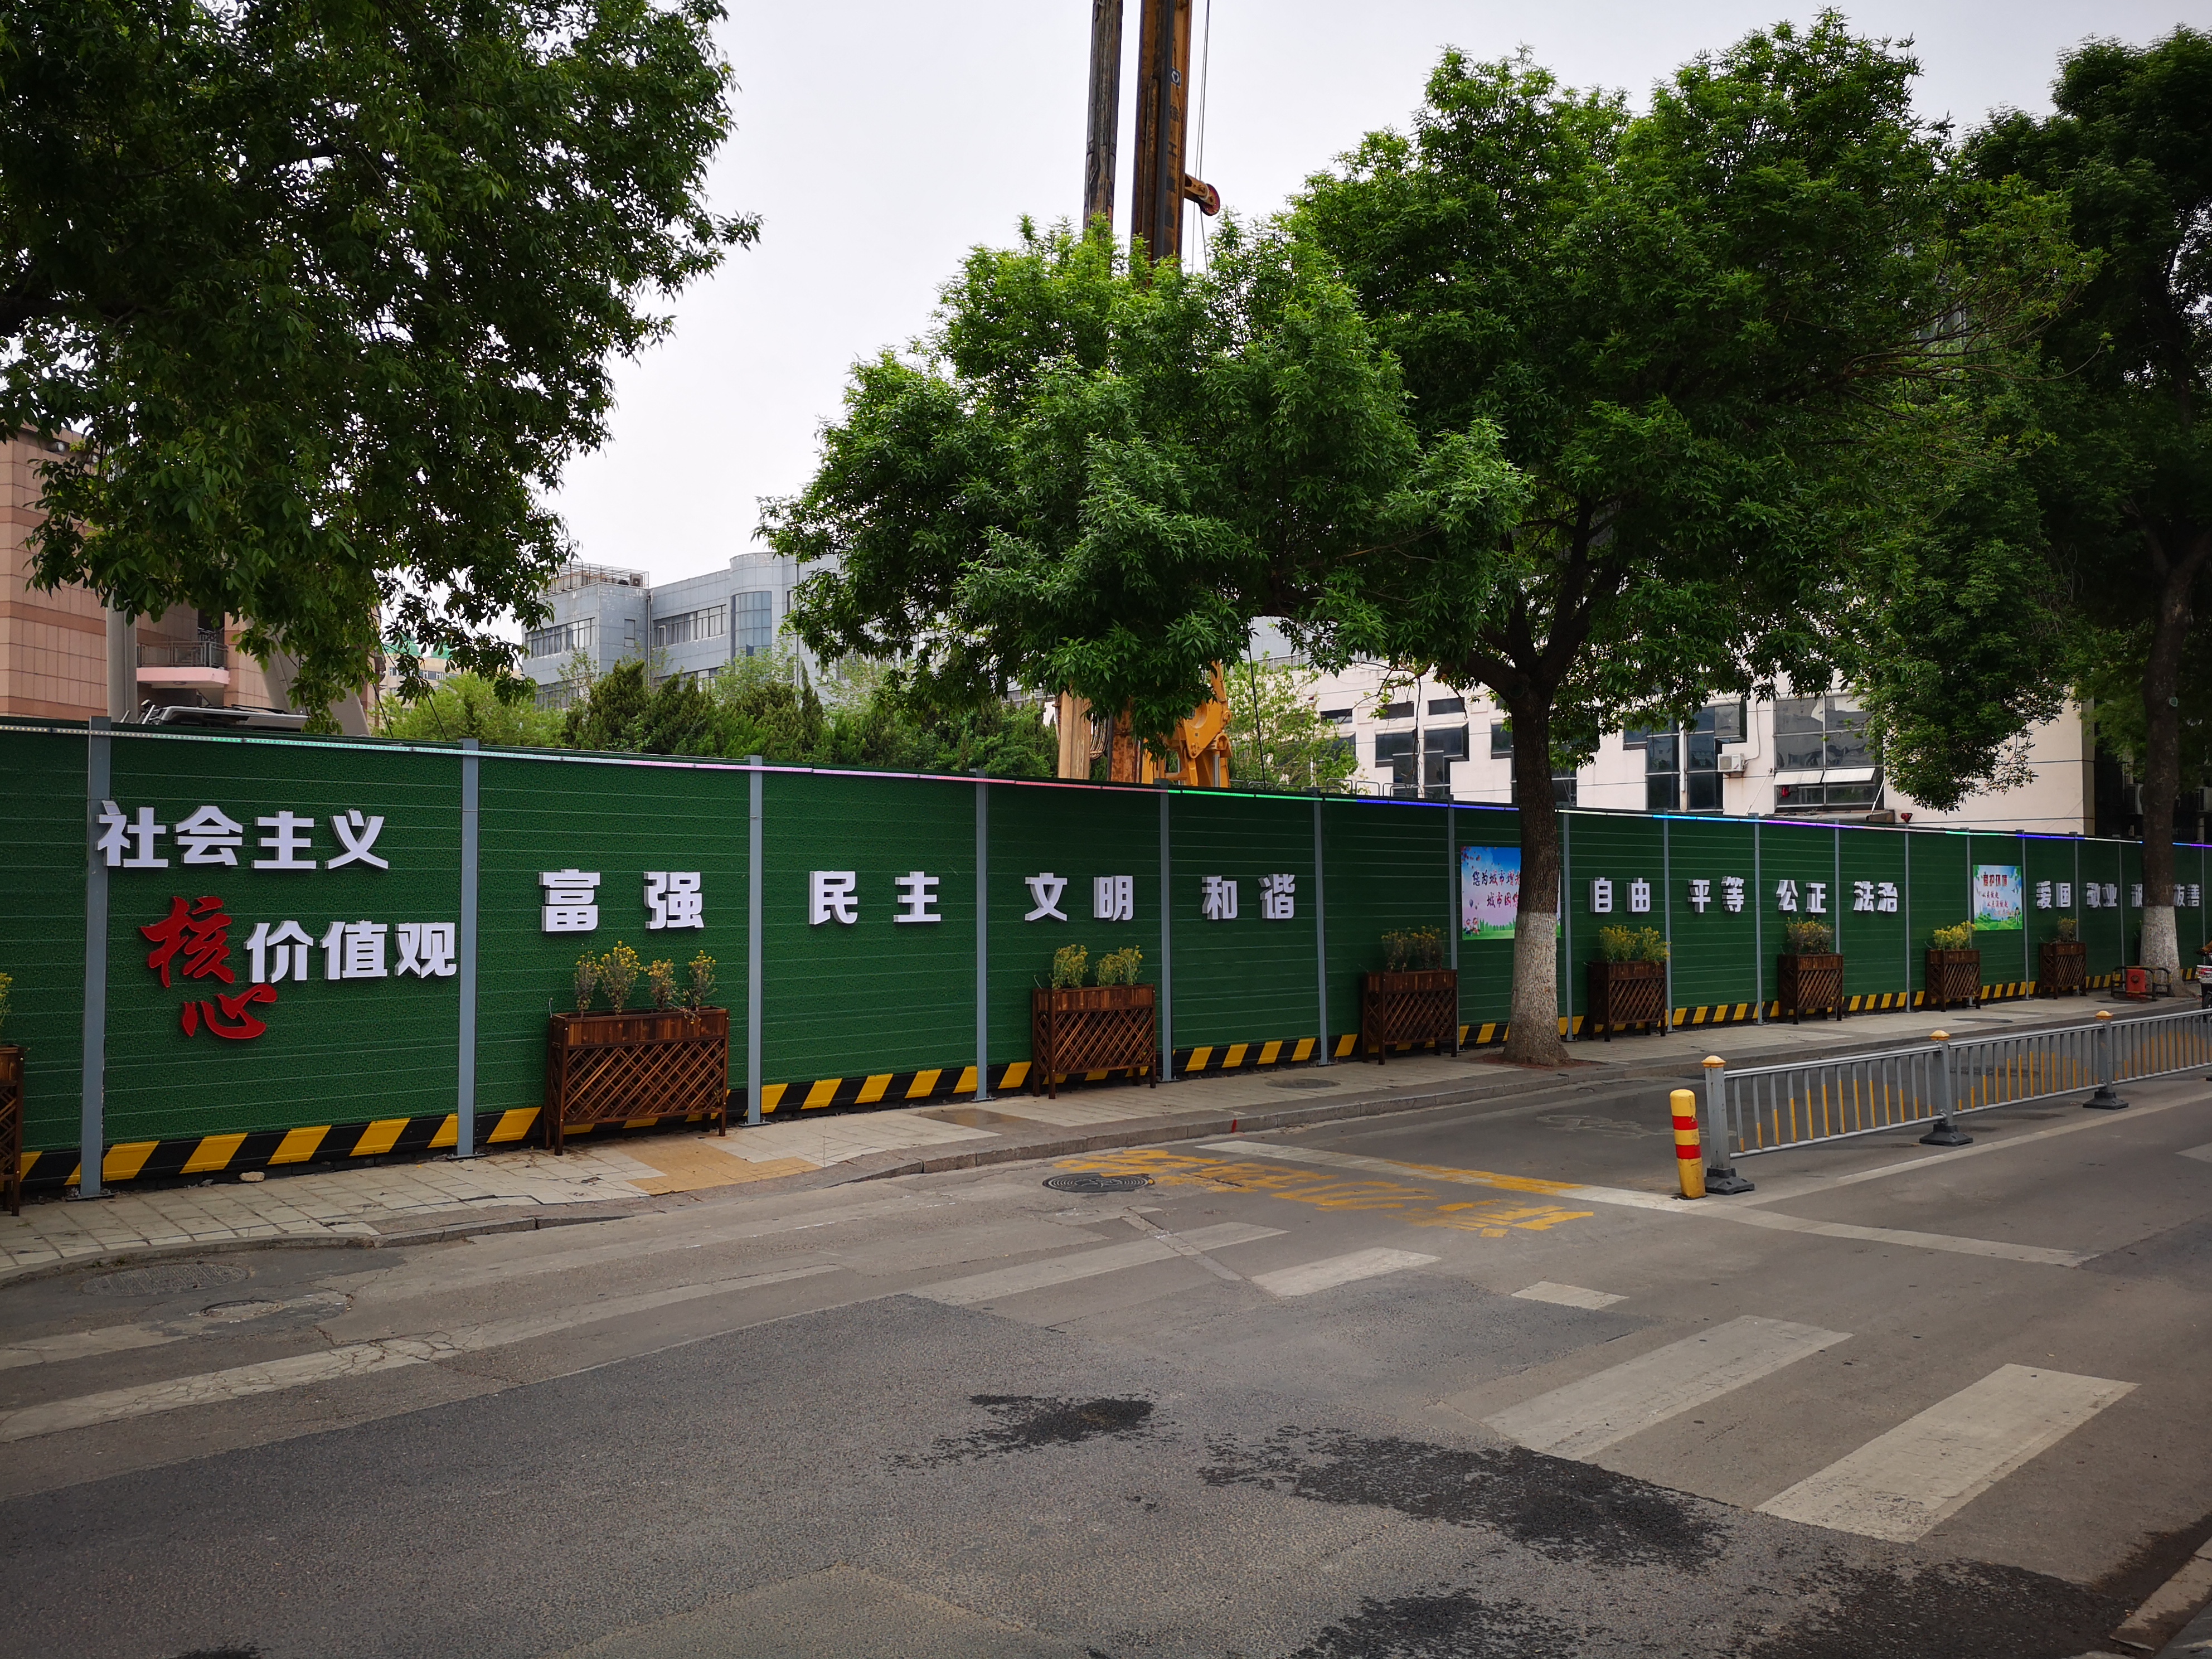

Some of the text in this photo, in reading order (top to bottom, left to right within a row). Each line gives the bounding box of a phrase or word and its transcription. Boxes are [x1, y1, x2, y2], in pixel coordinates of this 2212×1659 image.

[95, 801, 389, 870] 社会主义
[539, 869, 2200, 933] 富强 民主 文明 和谐 自由 平等 公正 法治 爱国 敬业 诚 友善
[1472, 869, 1521, 886] 您为城市增光
[1486, 891, 1519, 909] 城市因您
[140, 895, 278, 1040] 核心
[243, 920, 457, 983] 价值观
